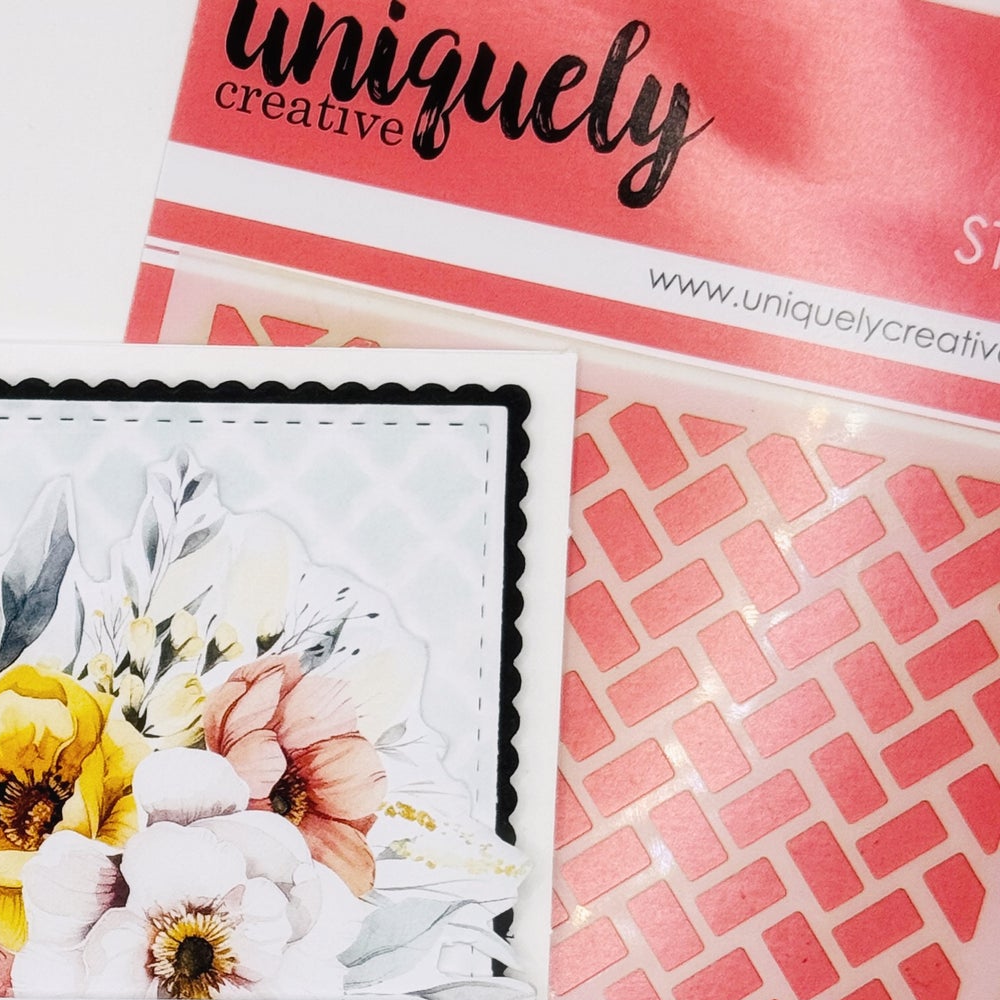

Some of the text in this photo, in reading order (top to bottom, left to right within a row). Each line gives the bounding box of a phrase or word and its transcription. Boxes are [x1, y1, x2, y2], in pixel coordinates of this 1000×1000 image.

[214, 80, 404, 146] creative
[225, 0, 715, 208] uniquely
[649, 268, 1000, 363] www.uniquelycreativ
